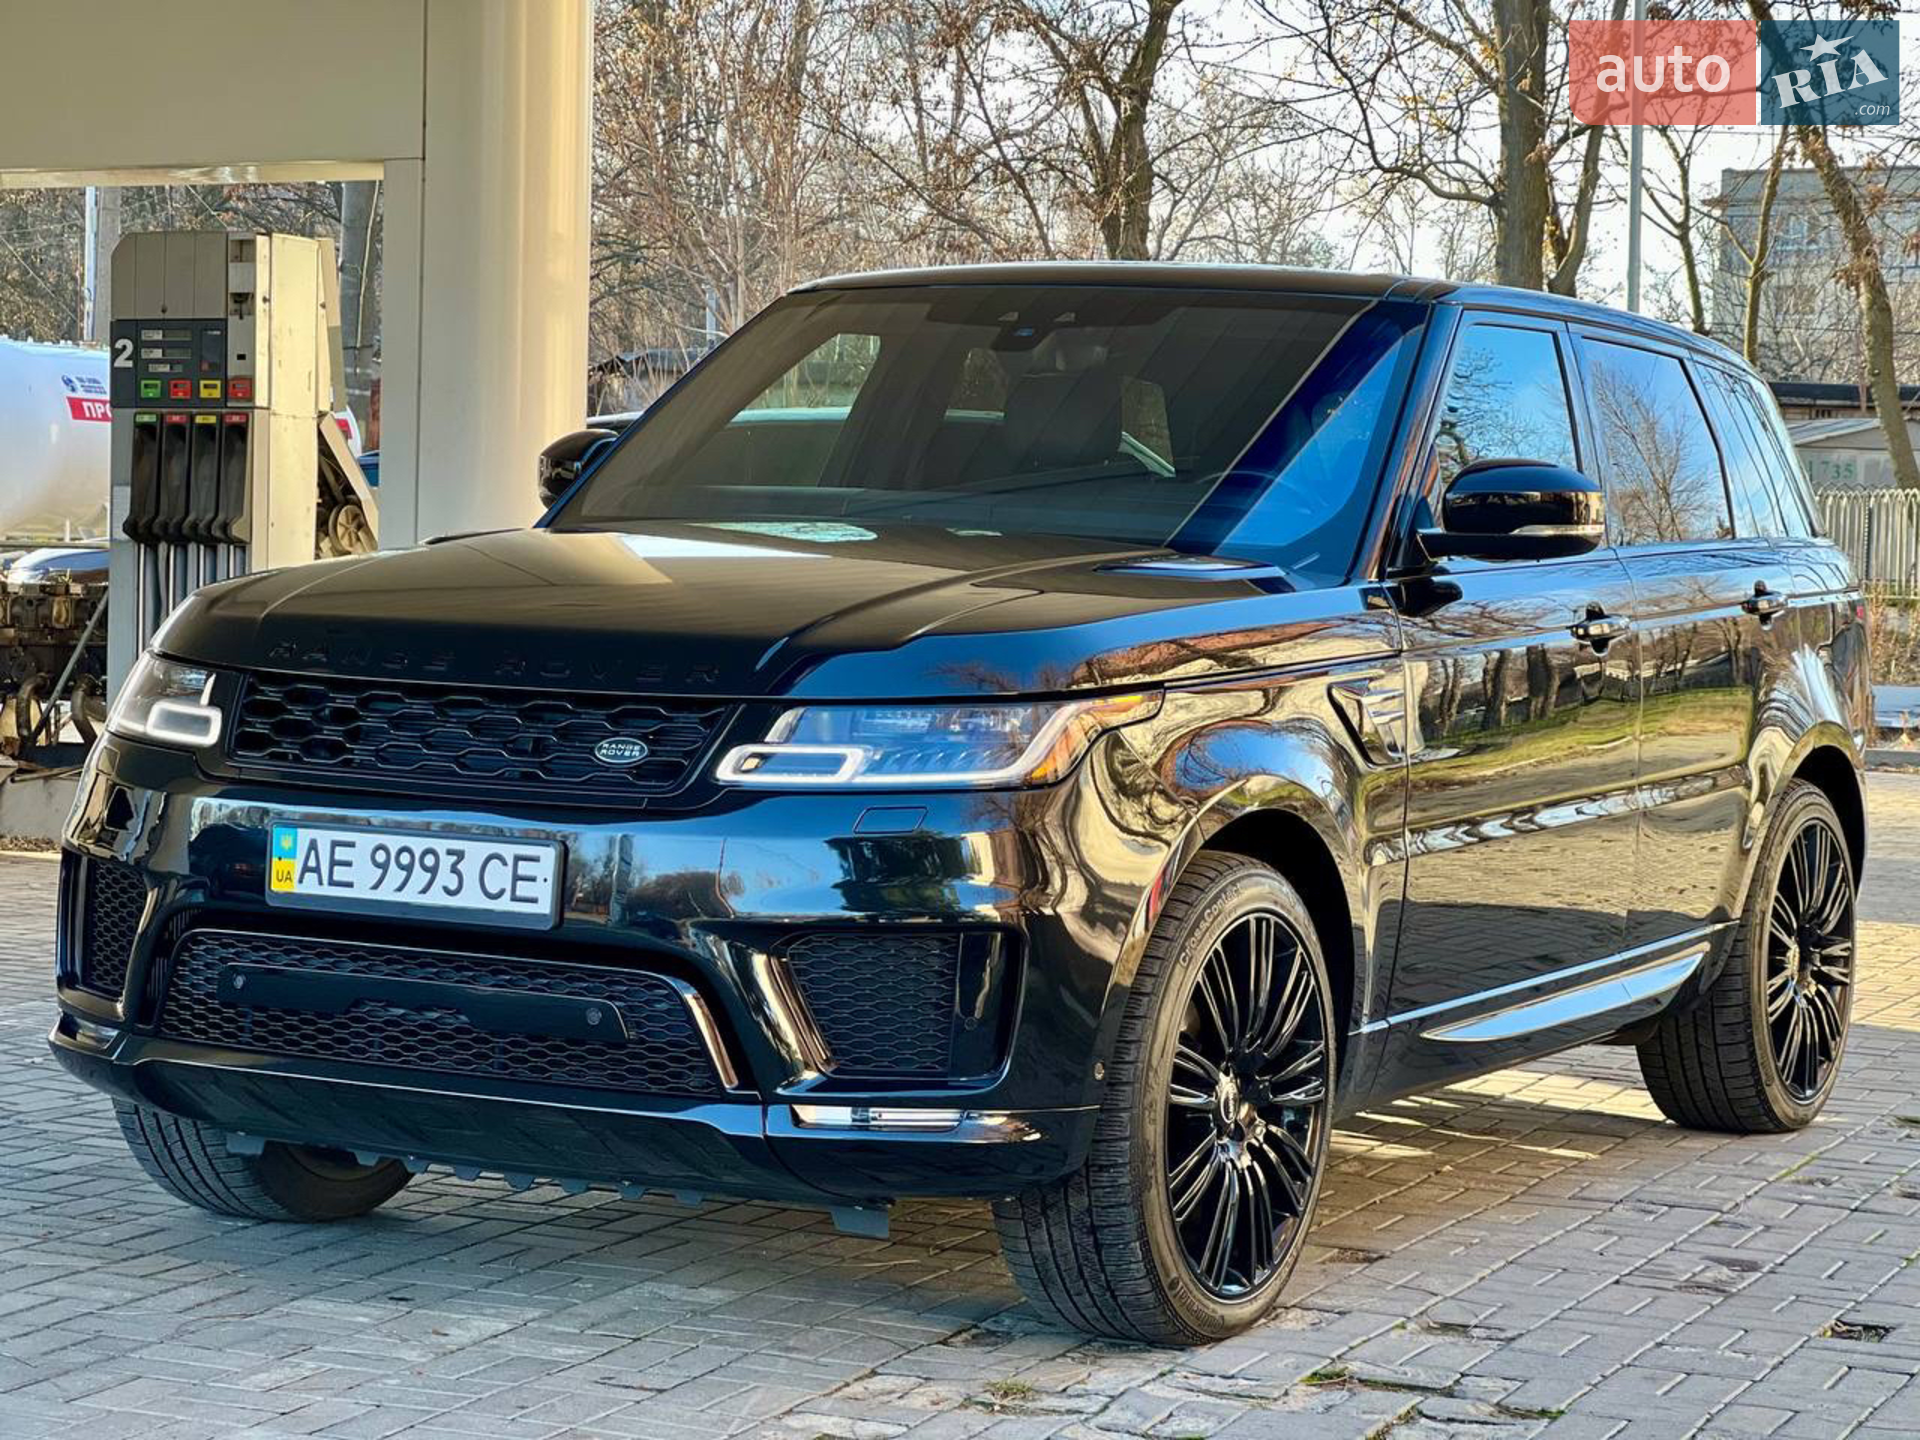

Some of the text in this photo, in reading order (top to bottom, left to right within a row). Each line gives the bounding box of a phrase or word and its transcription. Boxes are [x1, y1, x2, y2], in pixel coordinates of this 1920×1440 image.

[113, 338, 135, 368] 2
[599, 749, 640, 757] ROVER
[602, 743, 641, 751] RANGE
[275, 869, 293, 883] UA
[298, 838, 541, 904] AE 9993 CE
